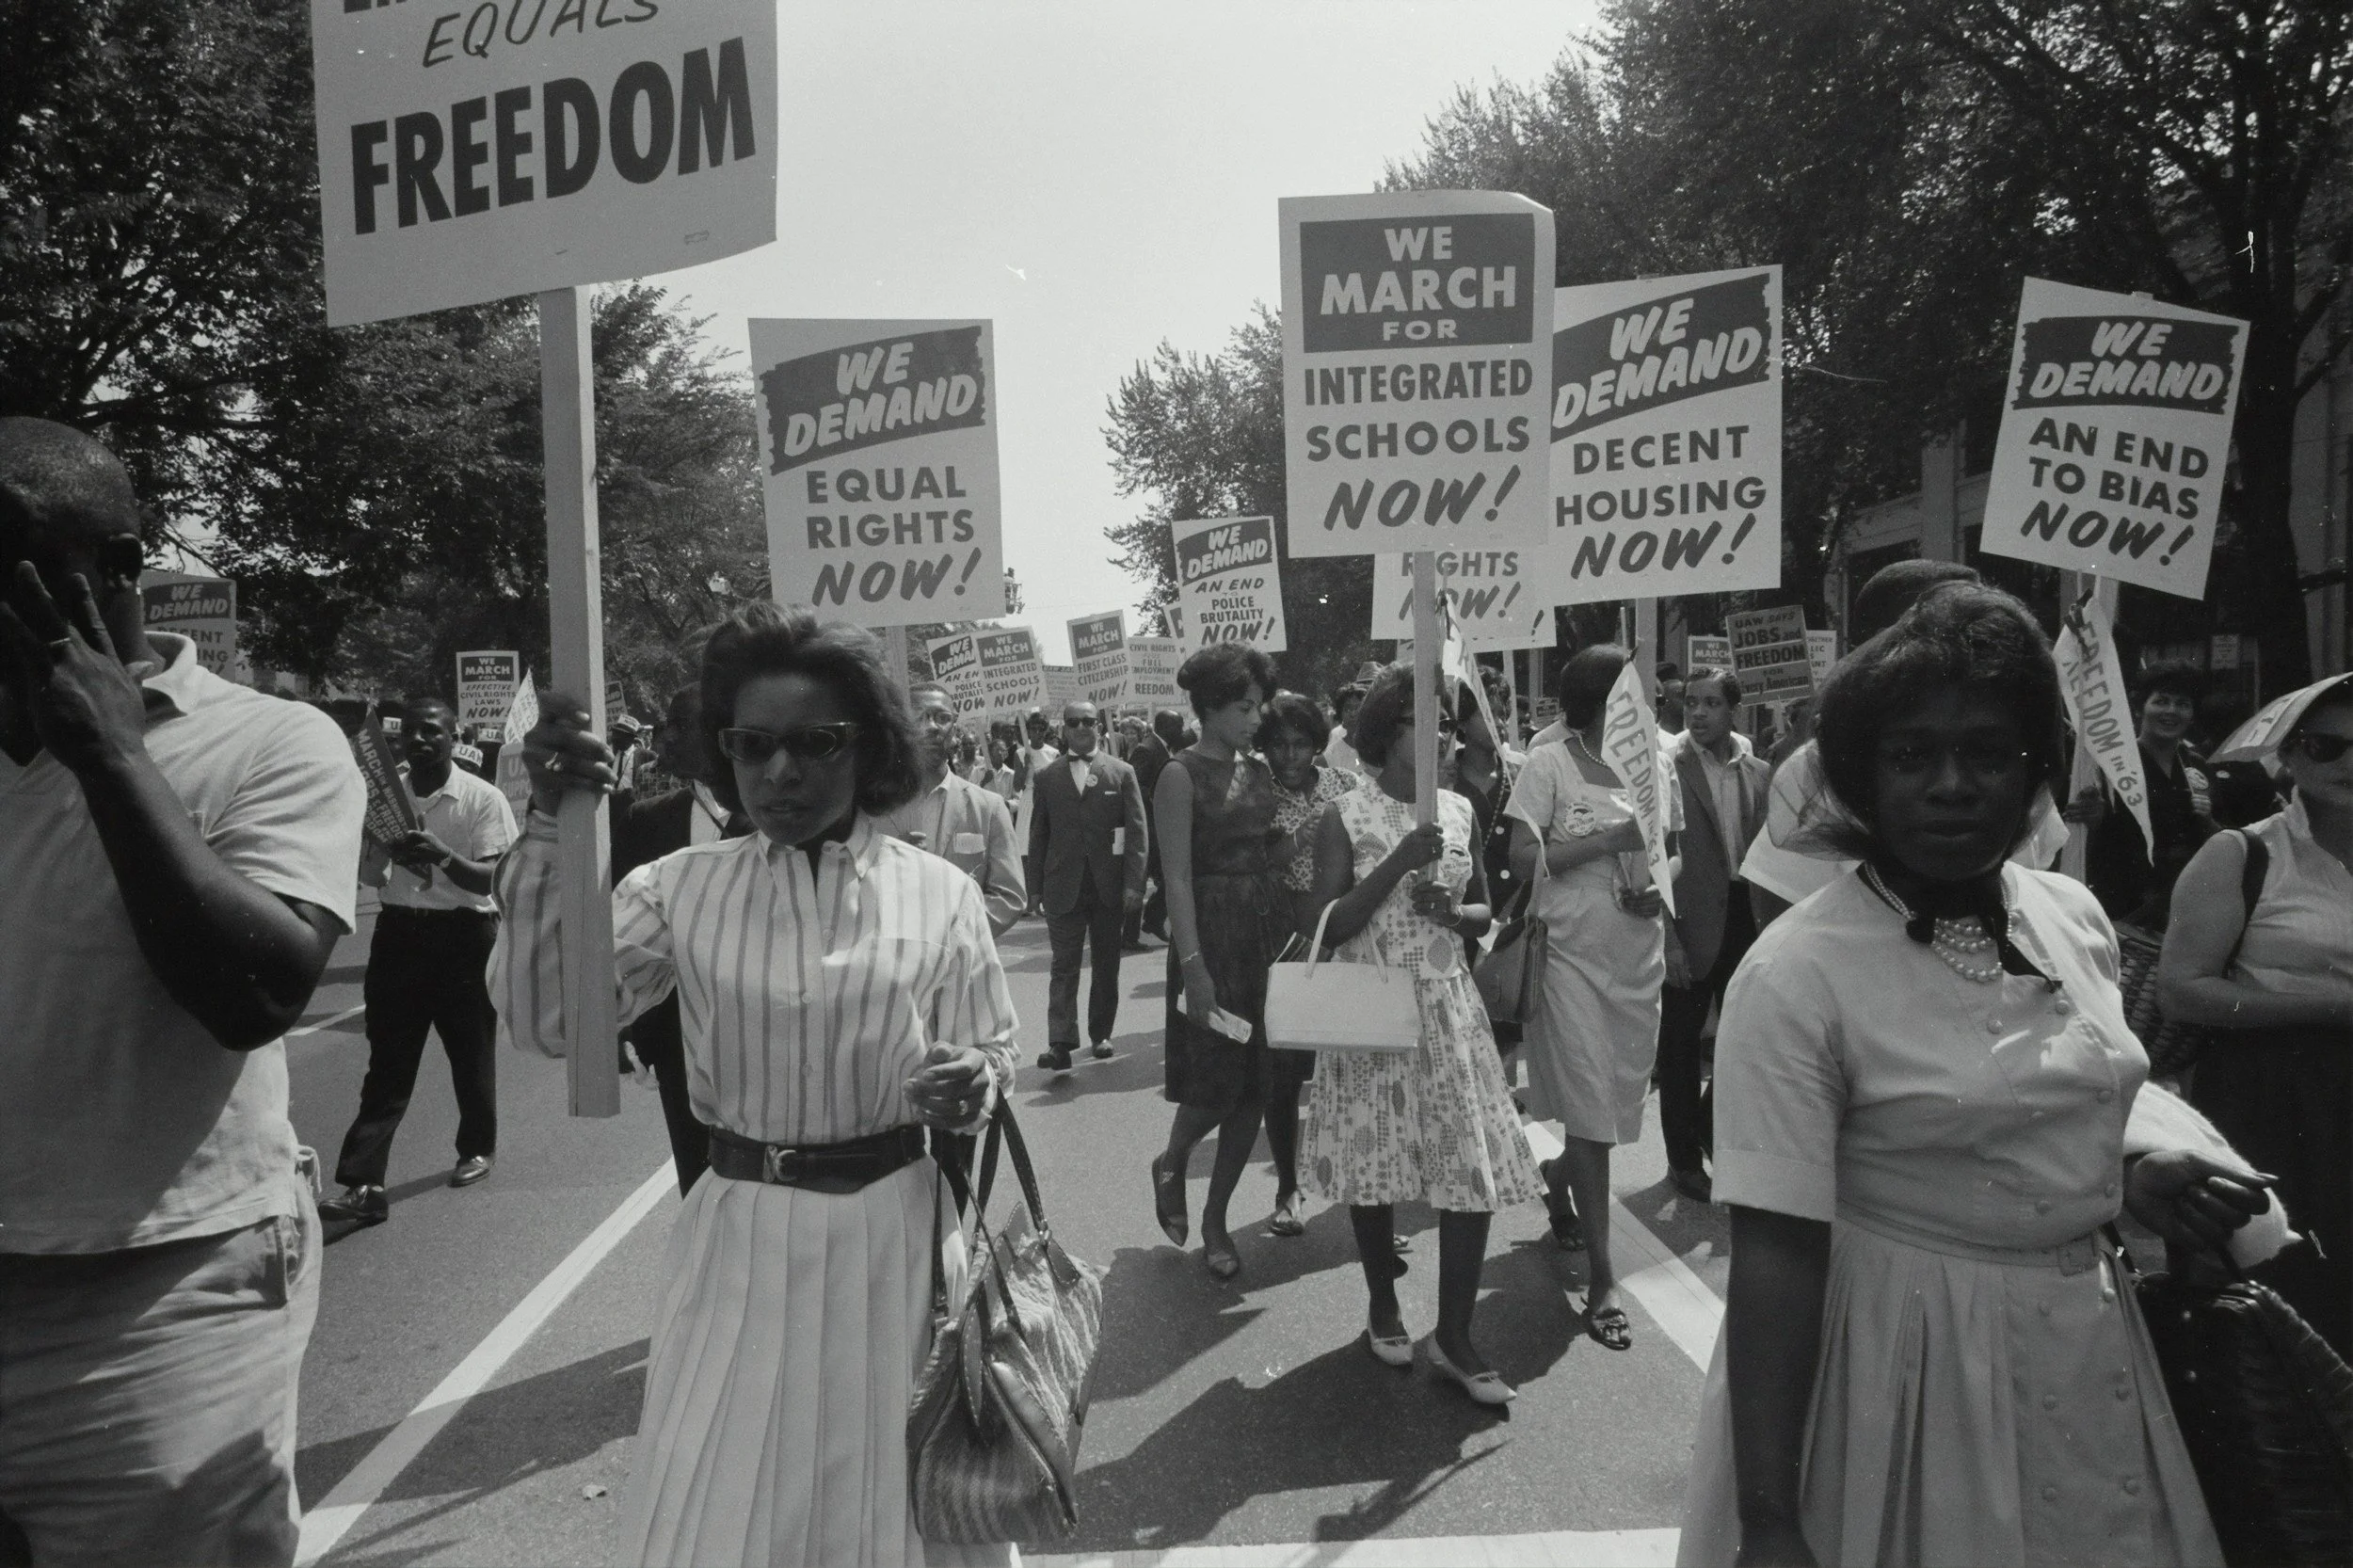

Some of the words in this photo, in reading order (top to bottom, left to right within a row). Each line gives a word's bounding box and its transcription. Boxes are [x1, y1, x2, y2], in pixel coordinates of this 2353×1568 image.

[423, 0, 659, 68] EQUALS
[350, 36, 756, 235] FREEDOM
[1384, 226, 1452, 262] WE
[1321, 266, 1516, 315] MARCH
[1383, 319, 1458, 341] FOR
[1609, 298, 1693, 360] WE
[2091, 321, 2172, 357] WE
[837, 342, 914, 395] WE
[1305, 359, 1533, 406] INTEGRATED
[1553, 327, 1762, 428] DEMAND
[2029, 360, 2224, 400] DEMAND
[784, 375, 977, 456] DEMAND
[1306, 416, 1529, 462] SCHOOLS
[1574, 425, 1749, 474] DECENT
[2028, 417, 2098, 456] AN
[2114, 431, 2209, 479] END
[807, 466, 967, 504] EQUAL
[1323, 464, 1521, 531] NOW!
[2028, 456, 2086, 494] TO
[2099, 470, 2200, 520] BIAS
[1557, 476, 1766, 527] HOUSING
[807, 509, 974, 550] RIGHTS
[1209, 525, 1241, 551] WE
[2021, 500, 2194, 567] NOW!
[1187, 538, 1268, 579] DEMAND
[1571, 513, 1756, 580] NOW!
[811, 547, 982, 607] NOW!
[1401, 552, 1519, 577] RGHTS
[171, 584, 204, 600] WE
[1195, 580, 1223, 593] AN
[1228, 577, 1264, 591] END
[150, 599, 228, 620] DEMAND
[1200, 609, 1263, 624] BRUTALITY
[1211, 596, 1255, 610] POLICE
[1090, 622, 1104, 633] WE
[1202, 616, 1275, 645] NOW!
[1735, 616, 1764, 629] UAW
[1769, 613, 1795, 622] SAYS
[949, 637, 970, 656] WE
[984, 642, 1029, 659] MARCH
[996, 635, 1012, 645] WE
[1079, 630, 1119, 649] MARCH
[1129, 644, 1147, 652] CIVIL
[1150, 644, 1176, 652] RIGHTS
[1735, 627, 1781, 648] JOBS
[1783, 627, 1801, 641] and
[465, 665, 510, 676] MARCH
[984, 663, 1037, 679] INTEGRATED
[1078, 659, 1100, 674] FIRST
[1103, 653, 1127, 666] CLASS
[1737, 644, 1804, 670] FREEDOM
[945, 674, 960, 683] AN
[986, 676, 1040, 693] SCHOOLS
[1078, 664, 1128, 686] CITIZENSHIP
[1766, 676, 1809, 690] American
[994, 687, 1039, 708] NOW!
[1088, 680, 1128, 703] NOW!
[2082, 620, 2124, 754] FREEDOM
[2111, 756, 2125, 772] IN
[357, 728, 387, 777] MARCH
[1605, 691, 1656, 820] FREEDOM
